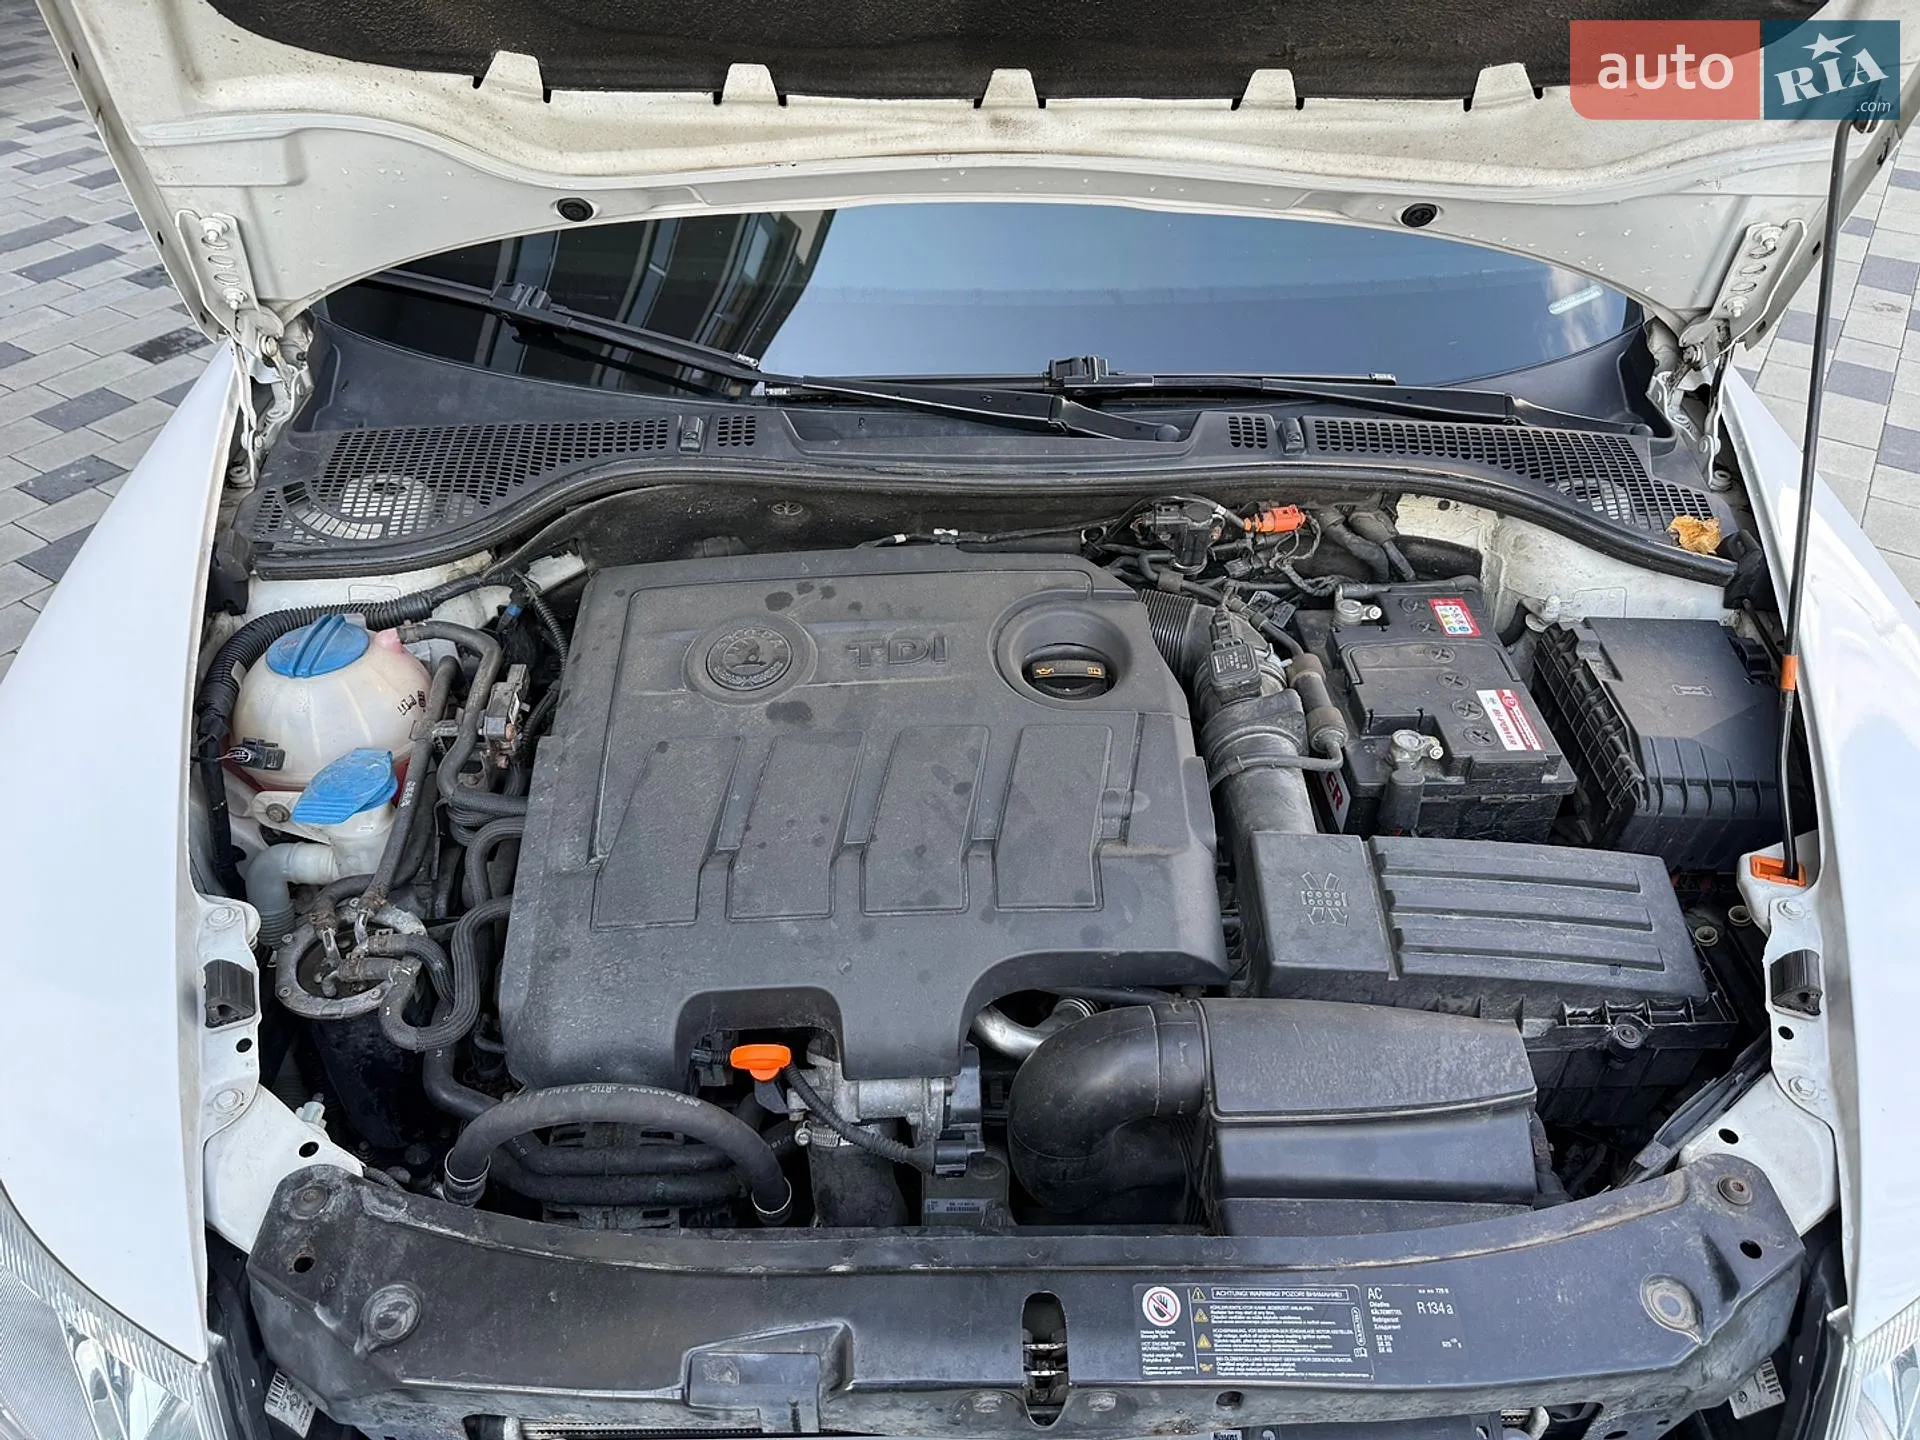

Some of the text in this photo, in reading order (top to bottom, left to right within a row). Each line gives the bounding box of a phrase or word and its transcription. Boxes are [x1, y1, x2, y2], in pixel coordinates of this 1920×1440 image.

[846, 632, 948, 669] TDI
[1367, 1287, 1383, 1300] AC
[1416, 1301, 1454, 1315] R134a
